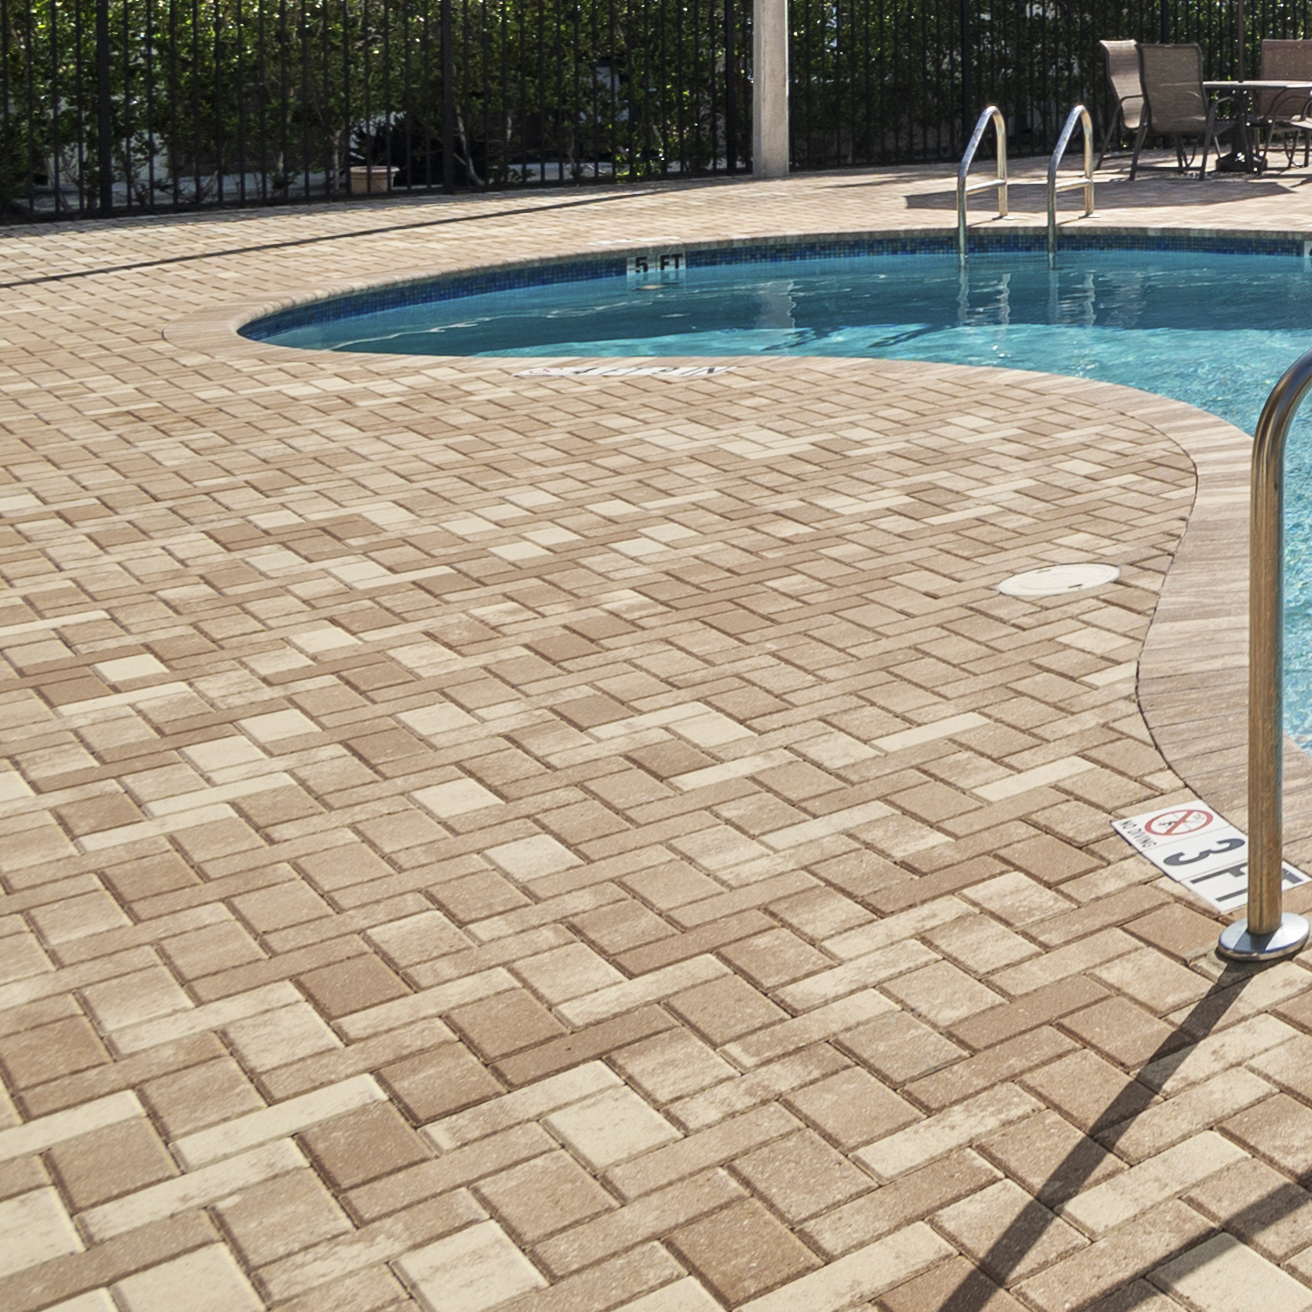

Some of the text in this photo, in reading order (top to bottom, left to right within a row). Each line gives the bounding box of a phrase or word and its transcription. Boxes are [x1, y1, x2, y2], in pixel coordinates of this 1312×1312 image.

[635, 253, 683, 273] 5 FT
[1119, 819, 1158, 848] NO DIVING
[1163, 838, 1246, 866] 3
